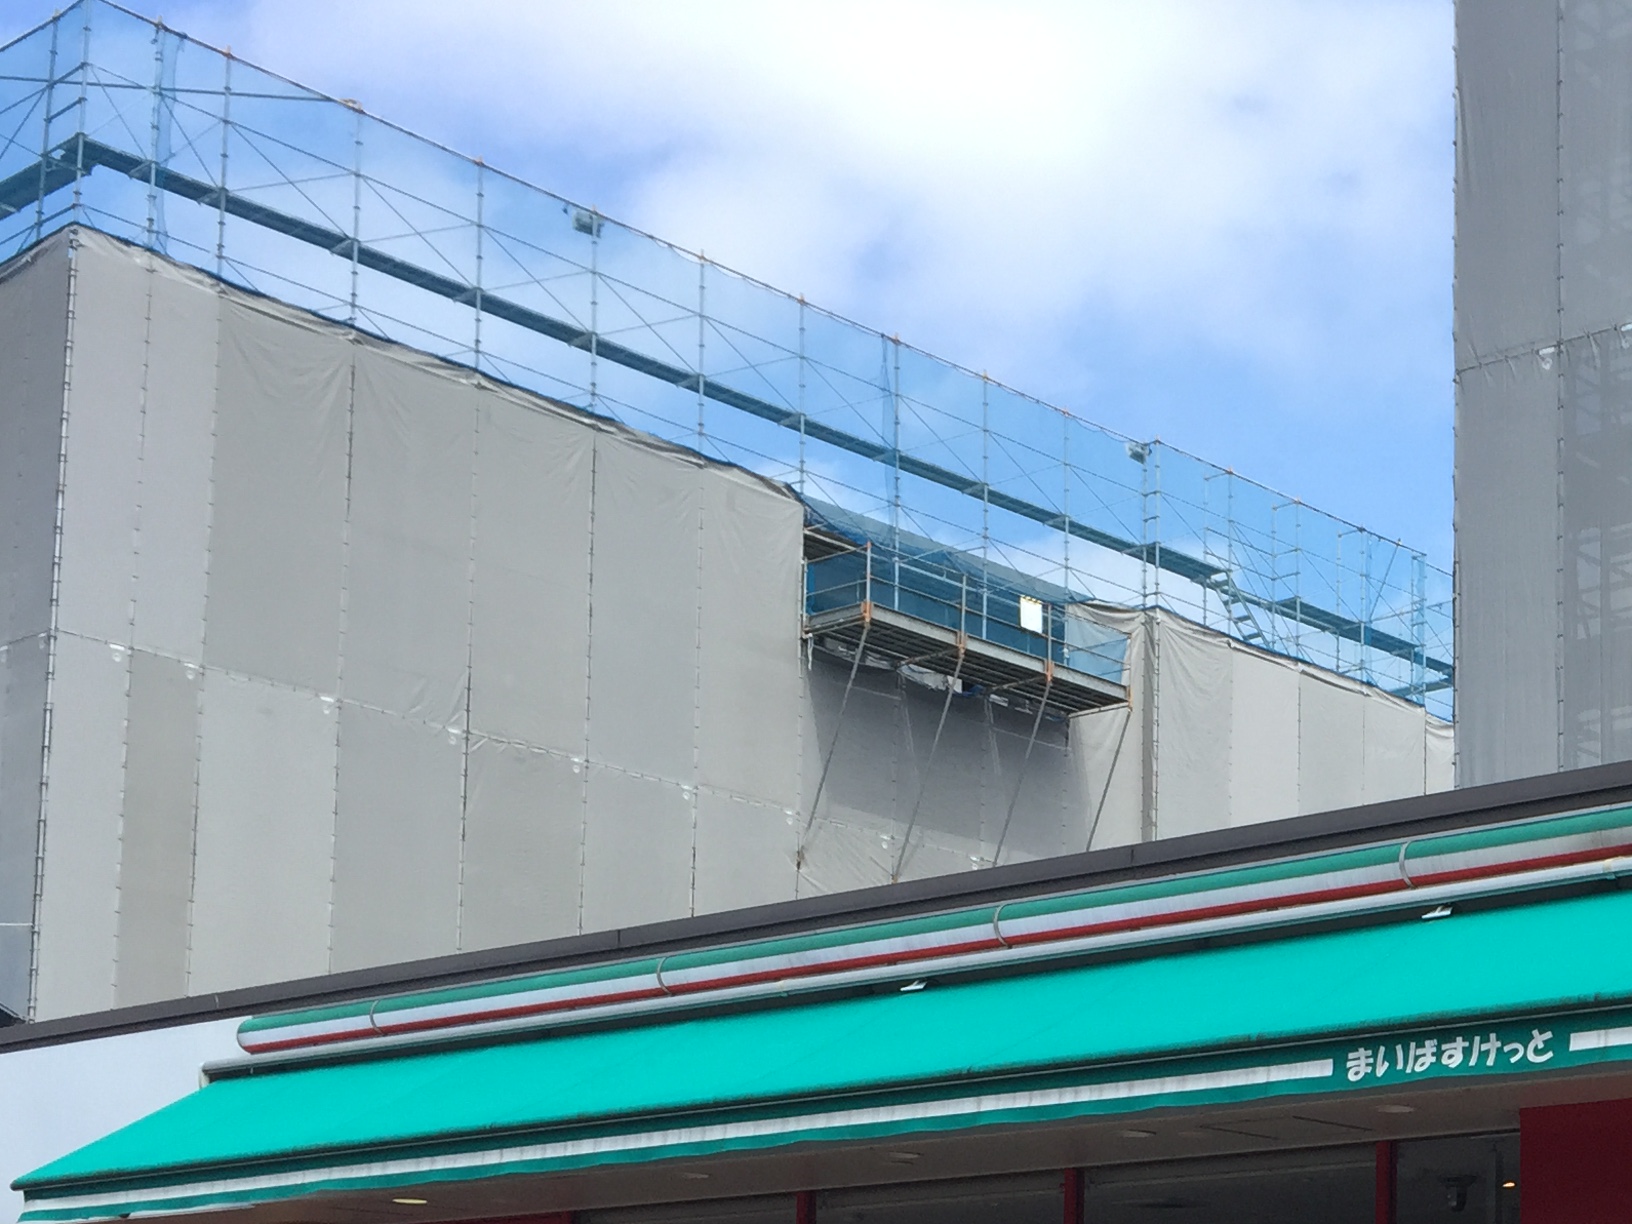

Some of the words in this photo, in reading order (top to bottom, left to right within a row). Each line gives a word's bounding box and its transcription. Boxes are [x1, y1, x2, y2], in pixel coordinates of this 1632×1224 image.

[1346, 1029, 1554, 1082] まいばすけっと
